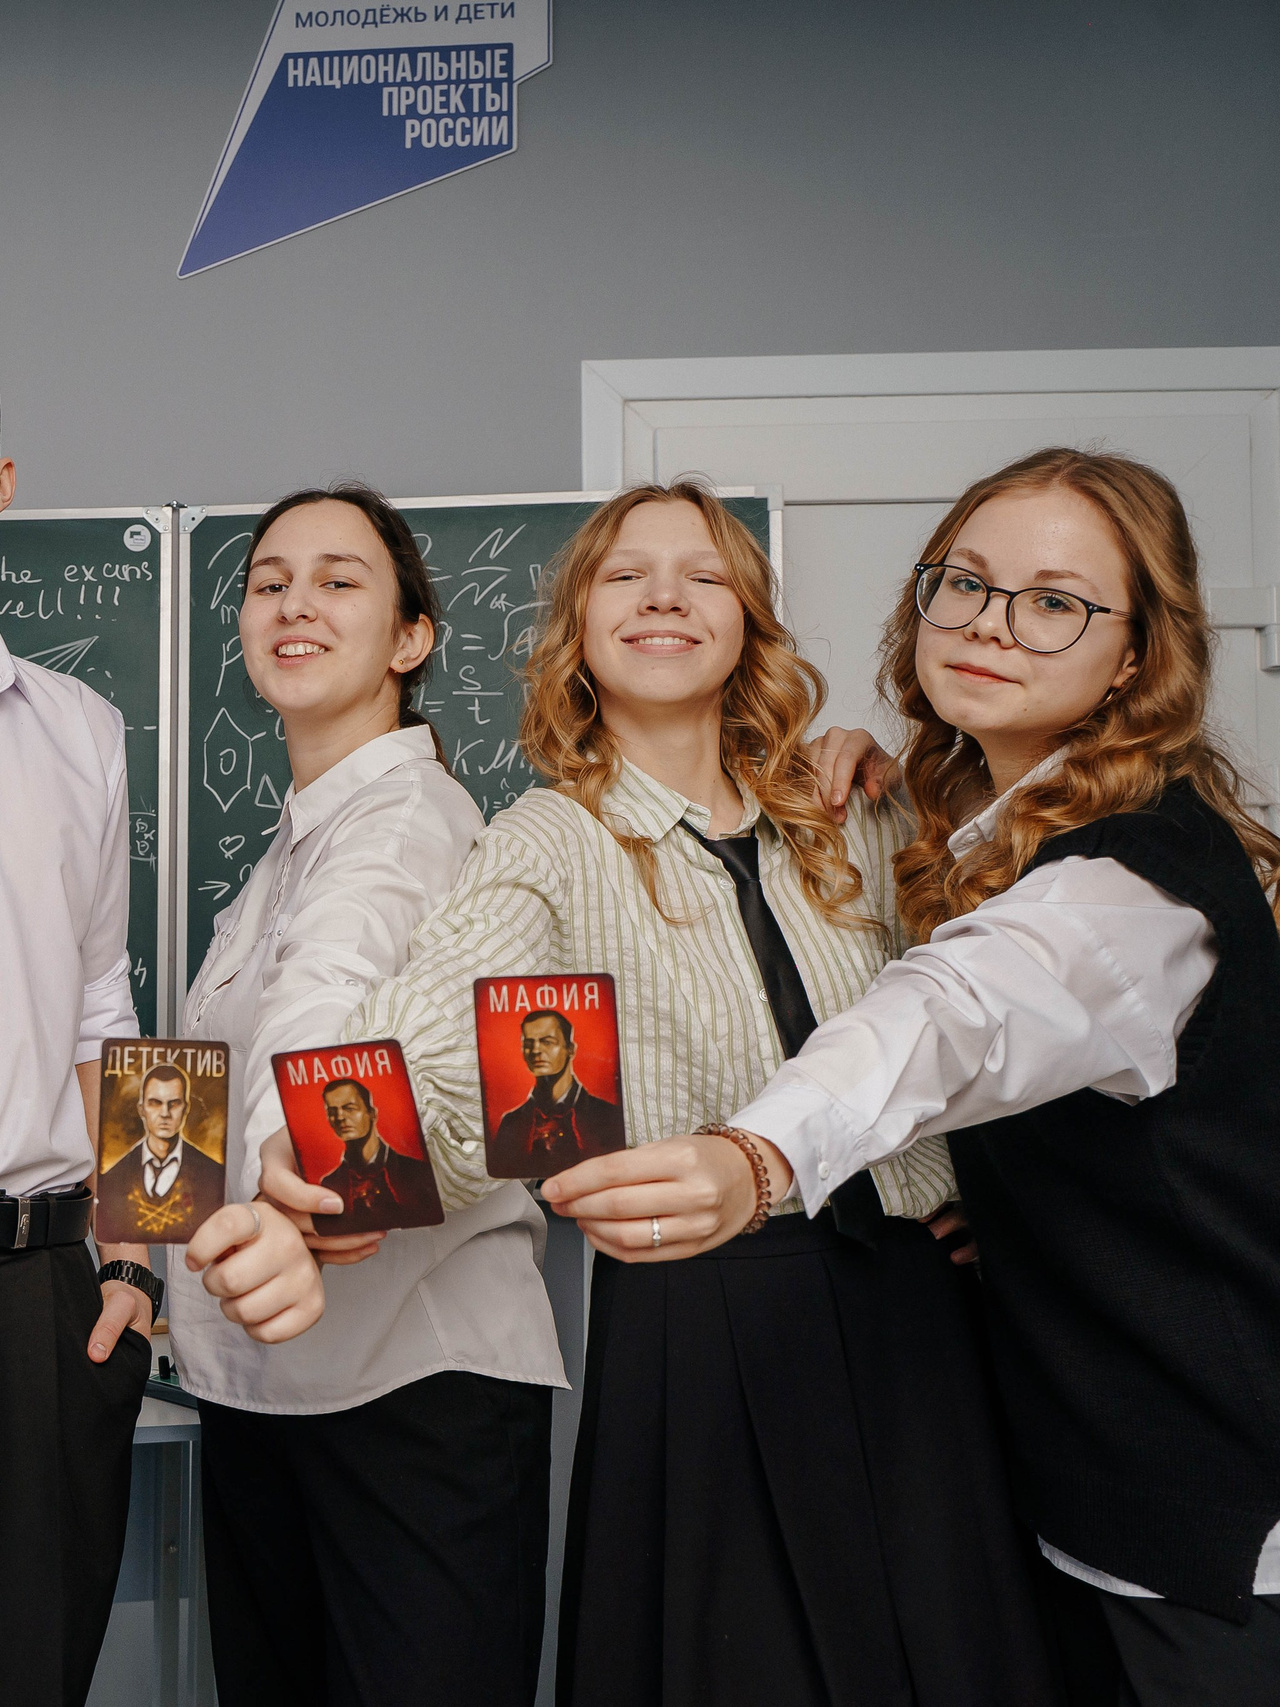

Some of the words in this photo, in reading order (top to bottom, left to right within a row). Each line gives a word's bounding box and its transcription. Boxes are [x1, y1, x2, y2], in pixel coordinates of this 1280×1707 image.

[295, 5, 427, 29] МОЛОДЁЖЬ
[433, 6, 449, 22] И
[454, 2, 516, 24] ДЕТИ
[287, 48, 509, 89] НАЦИОНАЛЬНЫЕ
[382, 82, 509, 117] ПРОЕКТЫ
[405, 116, 509, 149] РОССИИ
[489, 982, 600, 1013] МАФИЯ
[105, 1046, 227, 1078] ДЕТЕКТИВ
[287, 1048, 393, 1086] МАФИЯ
